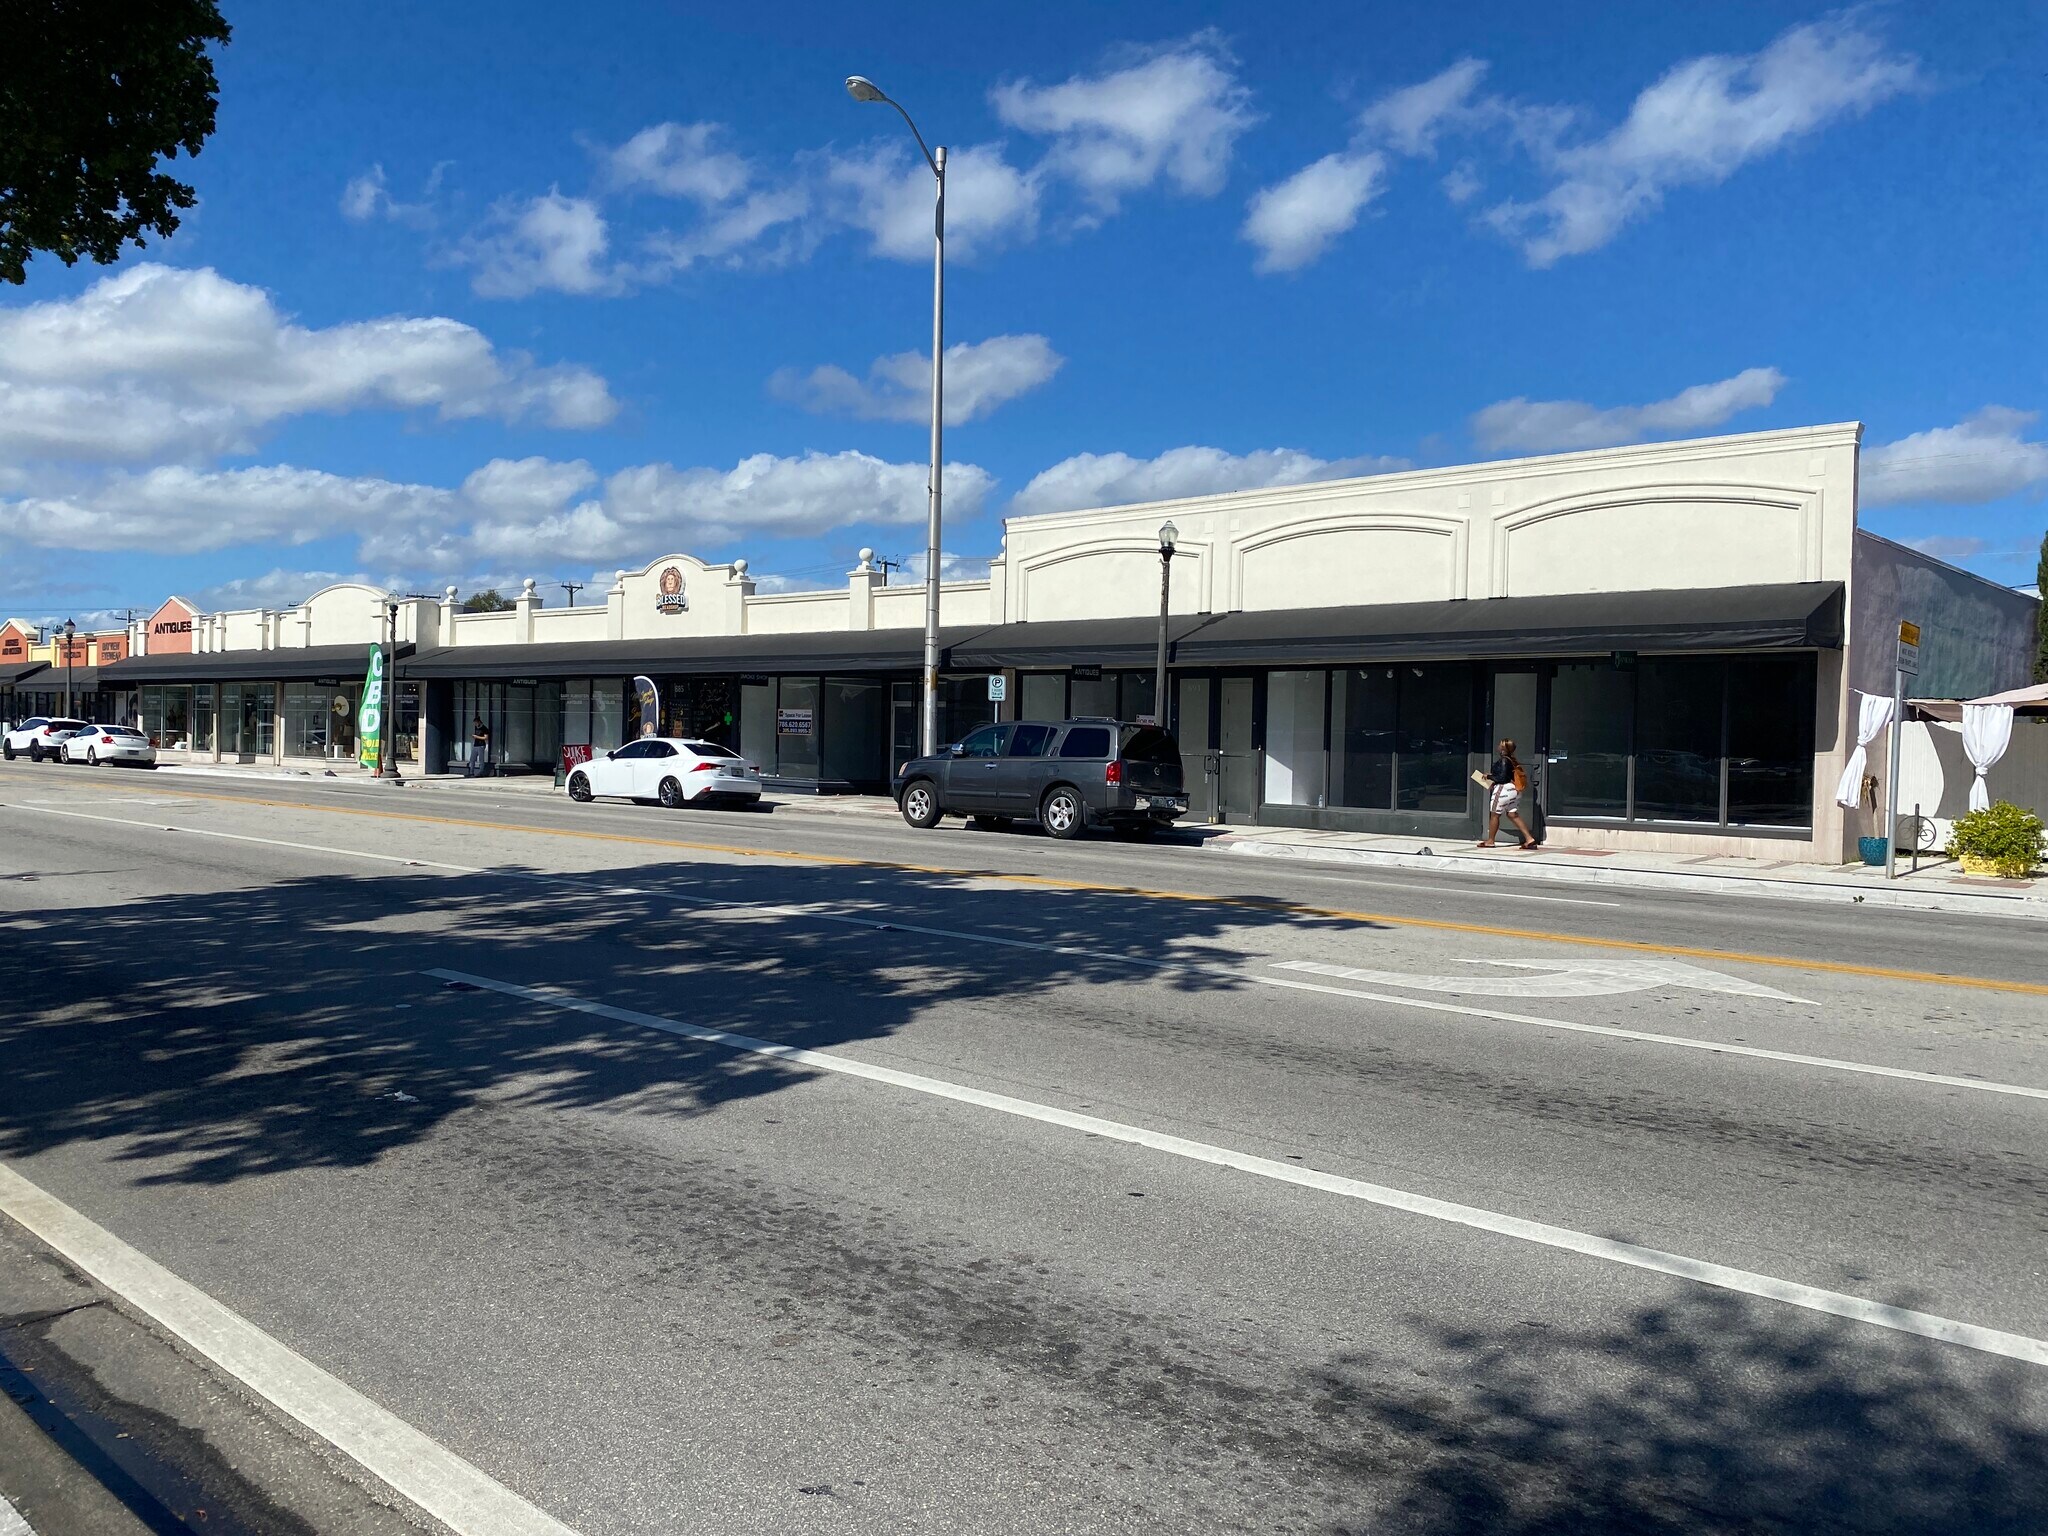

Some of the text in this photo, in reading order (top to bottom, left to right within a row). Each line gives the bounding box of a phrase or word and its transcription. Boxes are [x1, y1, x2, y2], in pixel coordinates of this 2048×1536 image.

[656, 594, 686, 606] BLESSED
[1074, 668, 1100, 677] ANTIQUES
[360, 651, 383, 733] CBD
